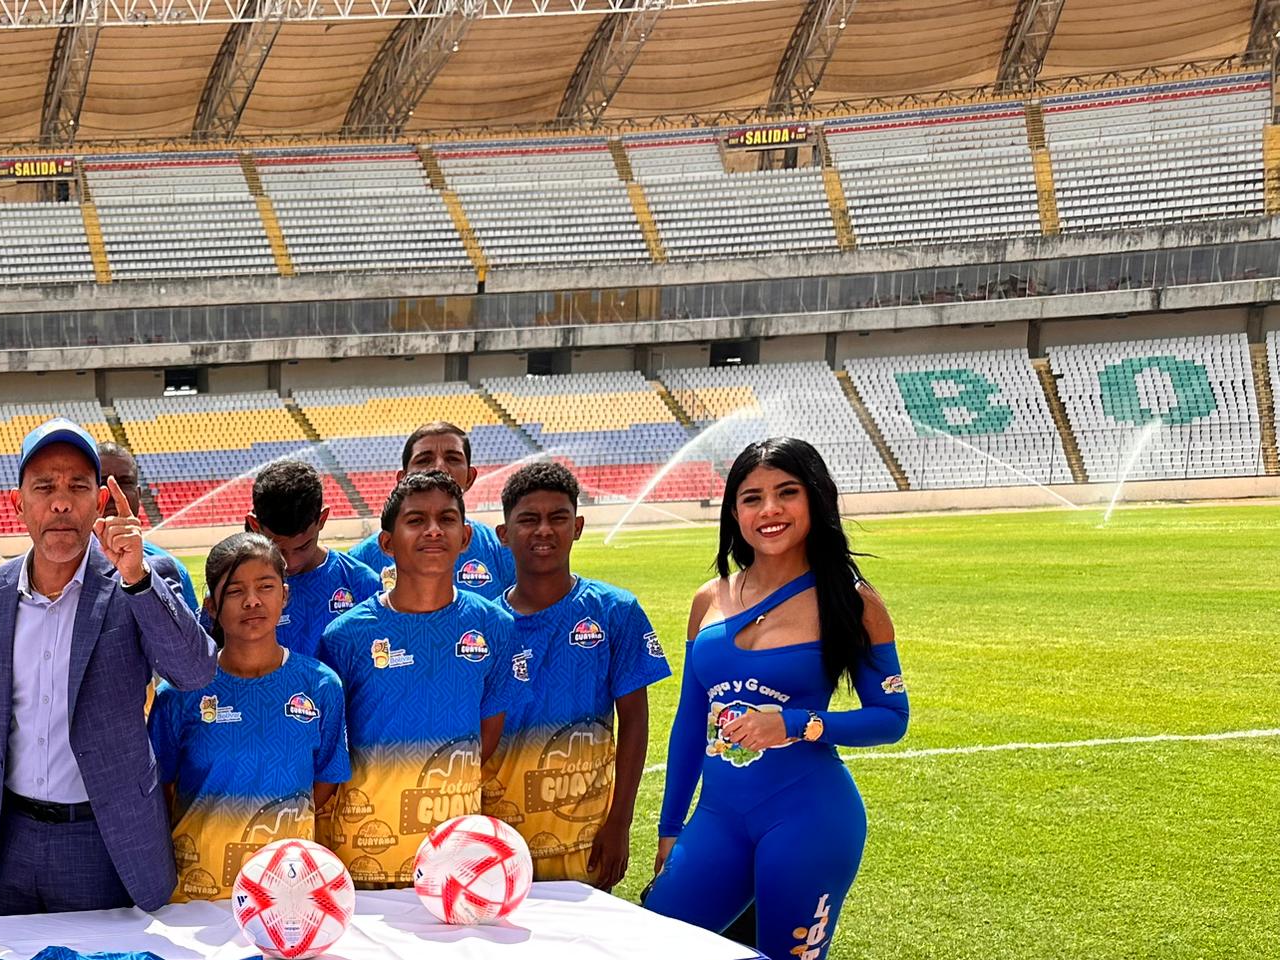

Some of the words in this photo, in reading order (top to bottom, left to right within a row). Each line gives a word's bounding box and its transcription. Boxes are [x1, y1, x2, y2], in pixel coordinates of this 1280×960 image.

[745, 128, 790, 145] SALIDA
[14, 161, 57, 177] SALIDA
[733, 680, 742, 693] y
[745, 678, 790, 703] Gana
[357, 836, 397, 847] GUAYANA
